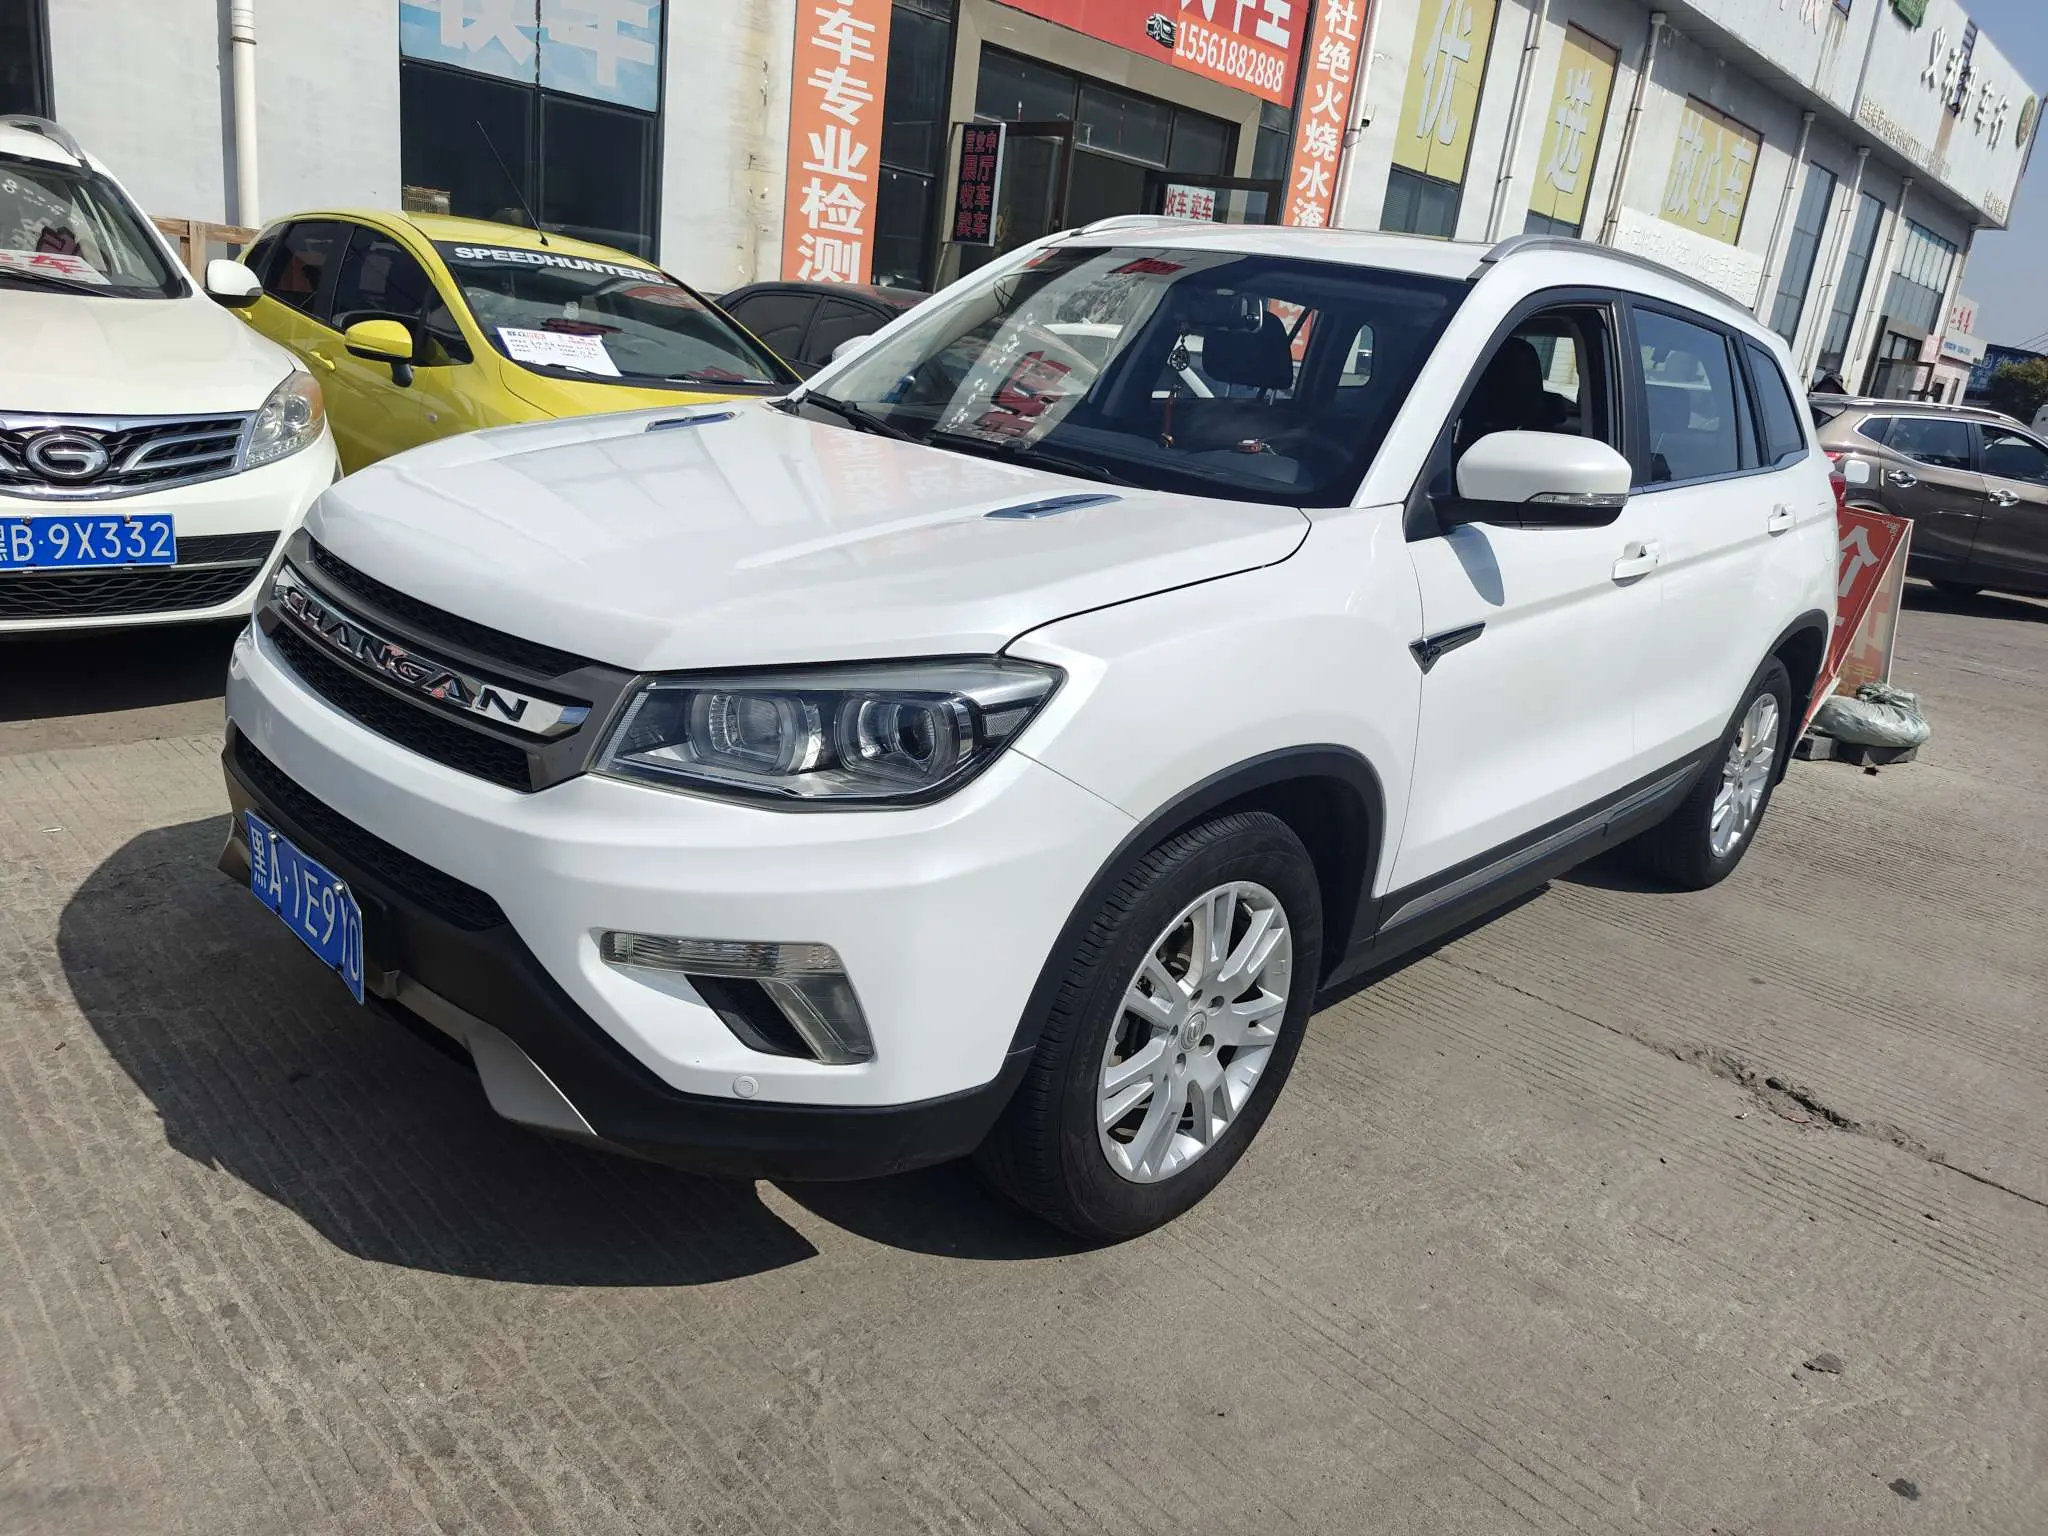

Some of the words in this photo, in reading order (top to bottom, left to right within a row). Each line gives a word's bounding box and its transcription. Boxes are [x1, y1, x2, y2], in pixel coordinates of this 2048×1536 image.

[1175, 21, 1285, 93] 15561882888
[1292, 0, 1357, 227] 杜绝火烧水淹
[1416, 0, 1472, 145] 优
[797, 0, 875, 284] 车专业检测
[1664, 110, 1751, 237] 放心车
[284, 586, 528, 723] CHANGAN
